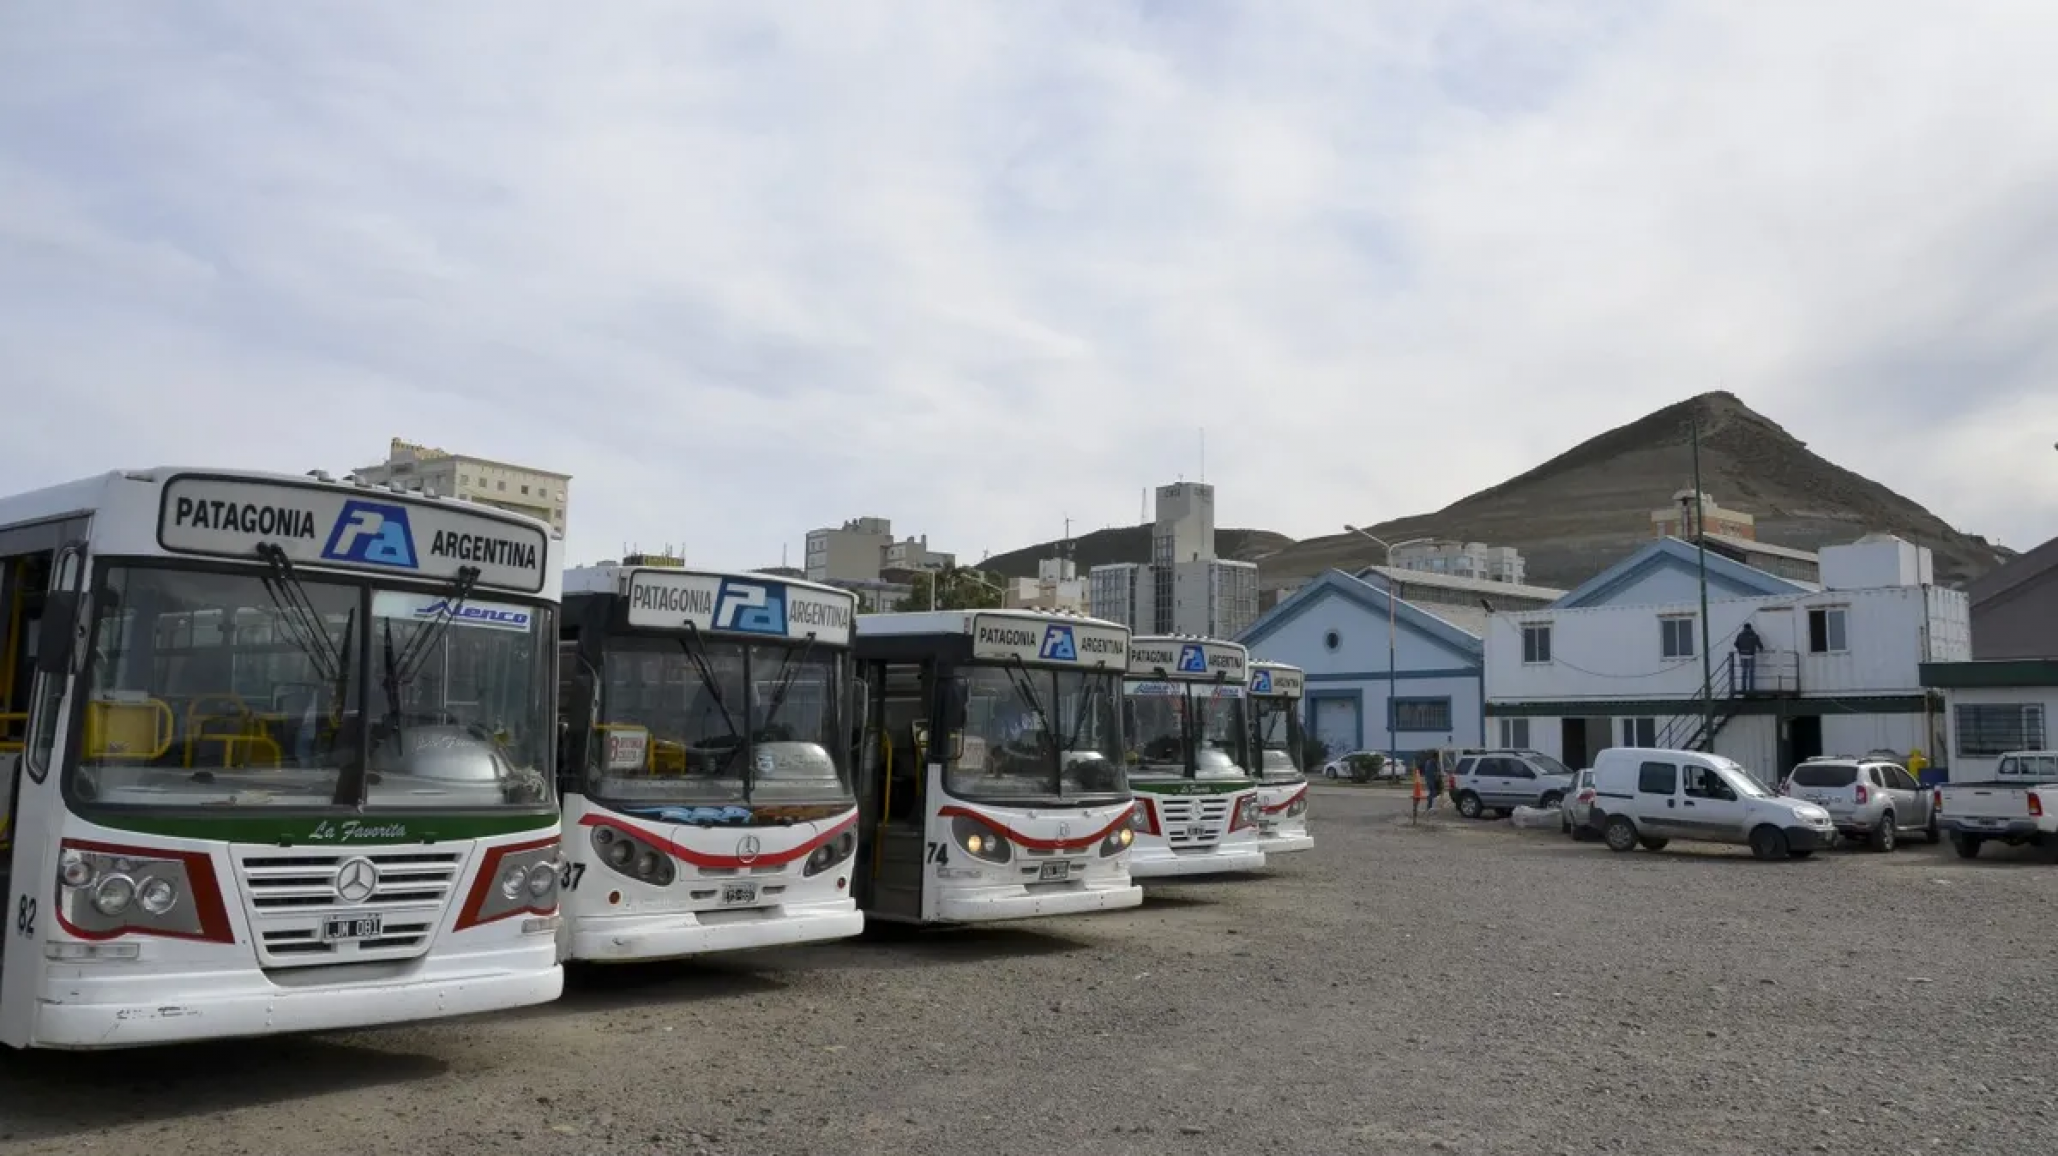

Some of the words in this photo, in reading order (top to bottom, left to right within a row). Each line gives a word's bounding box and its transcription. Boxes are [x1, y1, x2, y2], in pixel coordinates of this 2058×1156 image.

[176, 497, 316, 539] PATAGONIA
[431, 530, 536, 570] ARGENTINA
[632, 584, 713, 615] PATAGONIA
[788, 600, 849, 629] ARGENTINA
[980, 627, 1037, 647] PATAGONIA
[1081, 637, 1124, 655] ARGENTINA
[1131, 650, 1174, 663] PATAGONIA
[1208, 653, 1243, 668] ARGENTINA
[308, 820, 336, 840] La
[340, 820, 406, 842] Favorita
[927, 841, 949, 866] 74
[560, 861, 587, 891] 37
[18, 893, 37, 936] 82
